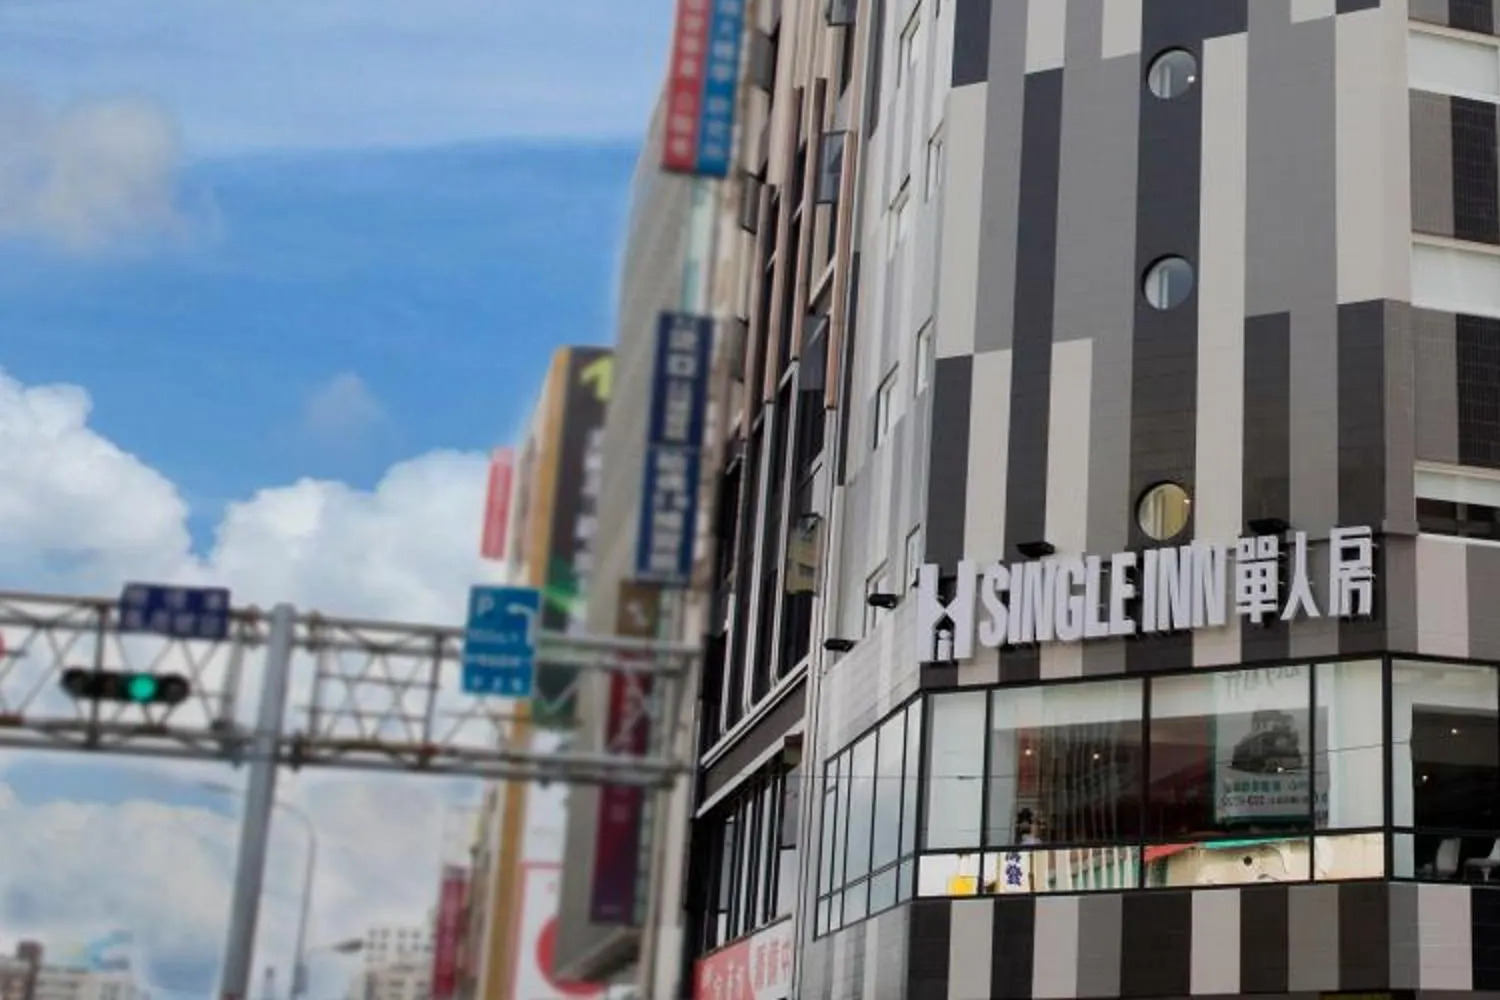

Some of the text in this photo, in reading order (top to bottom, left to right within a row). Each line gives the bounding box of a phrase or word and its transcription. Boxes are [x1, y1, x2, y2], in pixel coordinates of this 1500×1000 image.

[980, 551, 1137, 647] SINGLE
[1141, 542, 1227, 633] INN
[1236, 526, 1373, 623] 單人房
